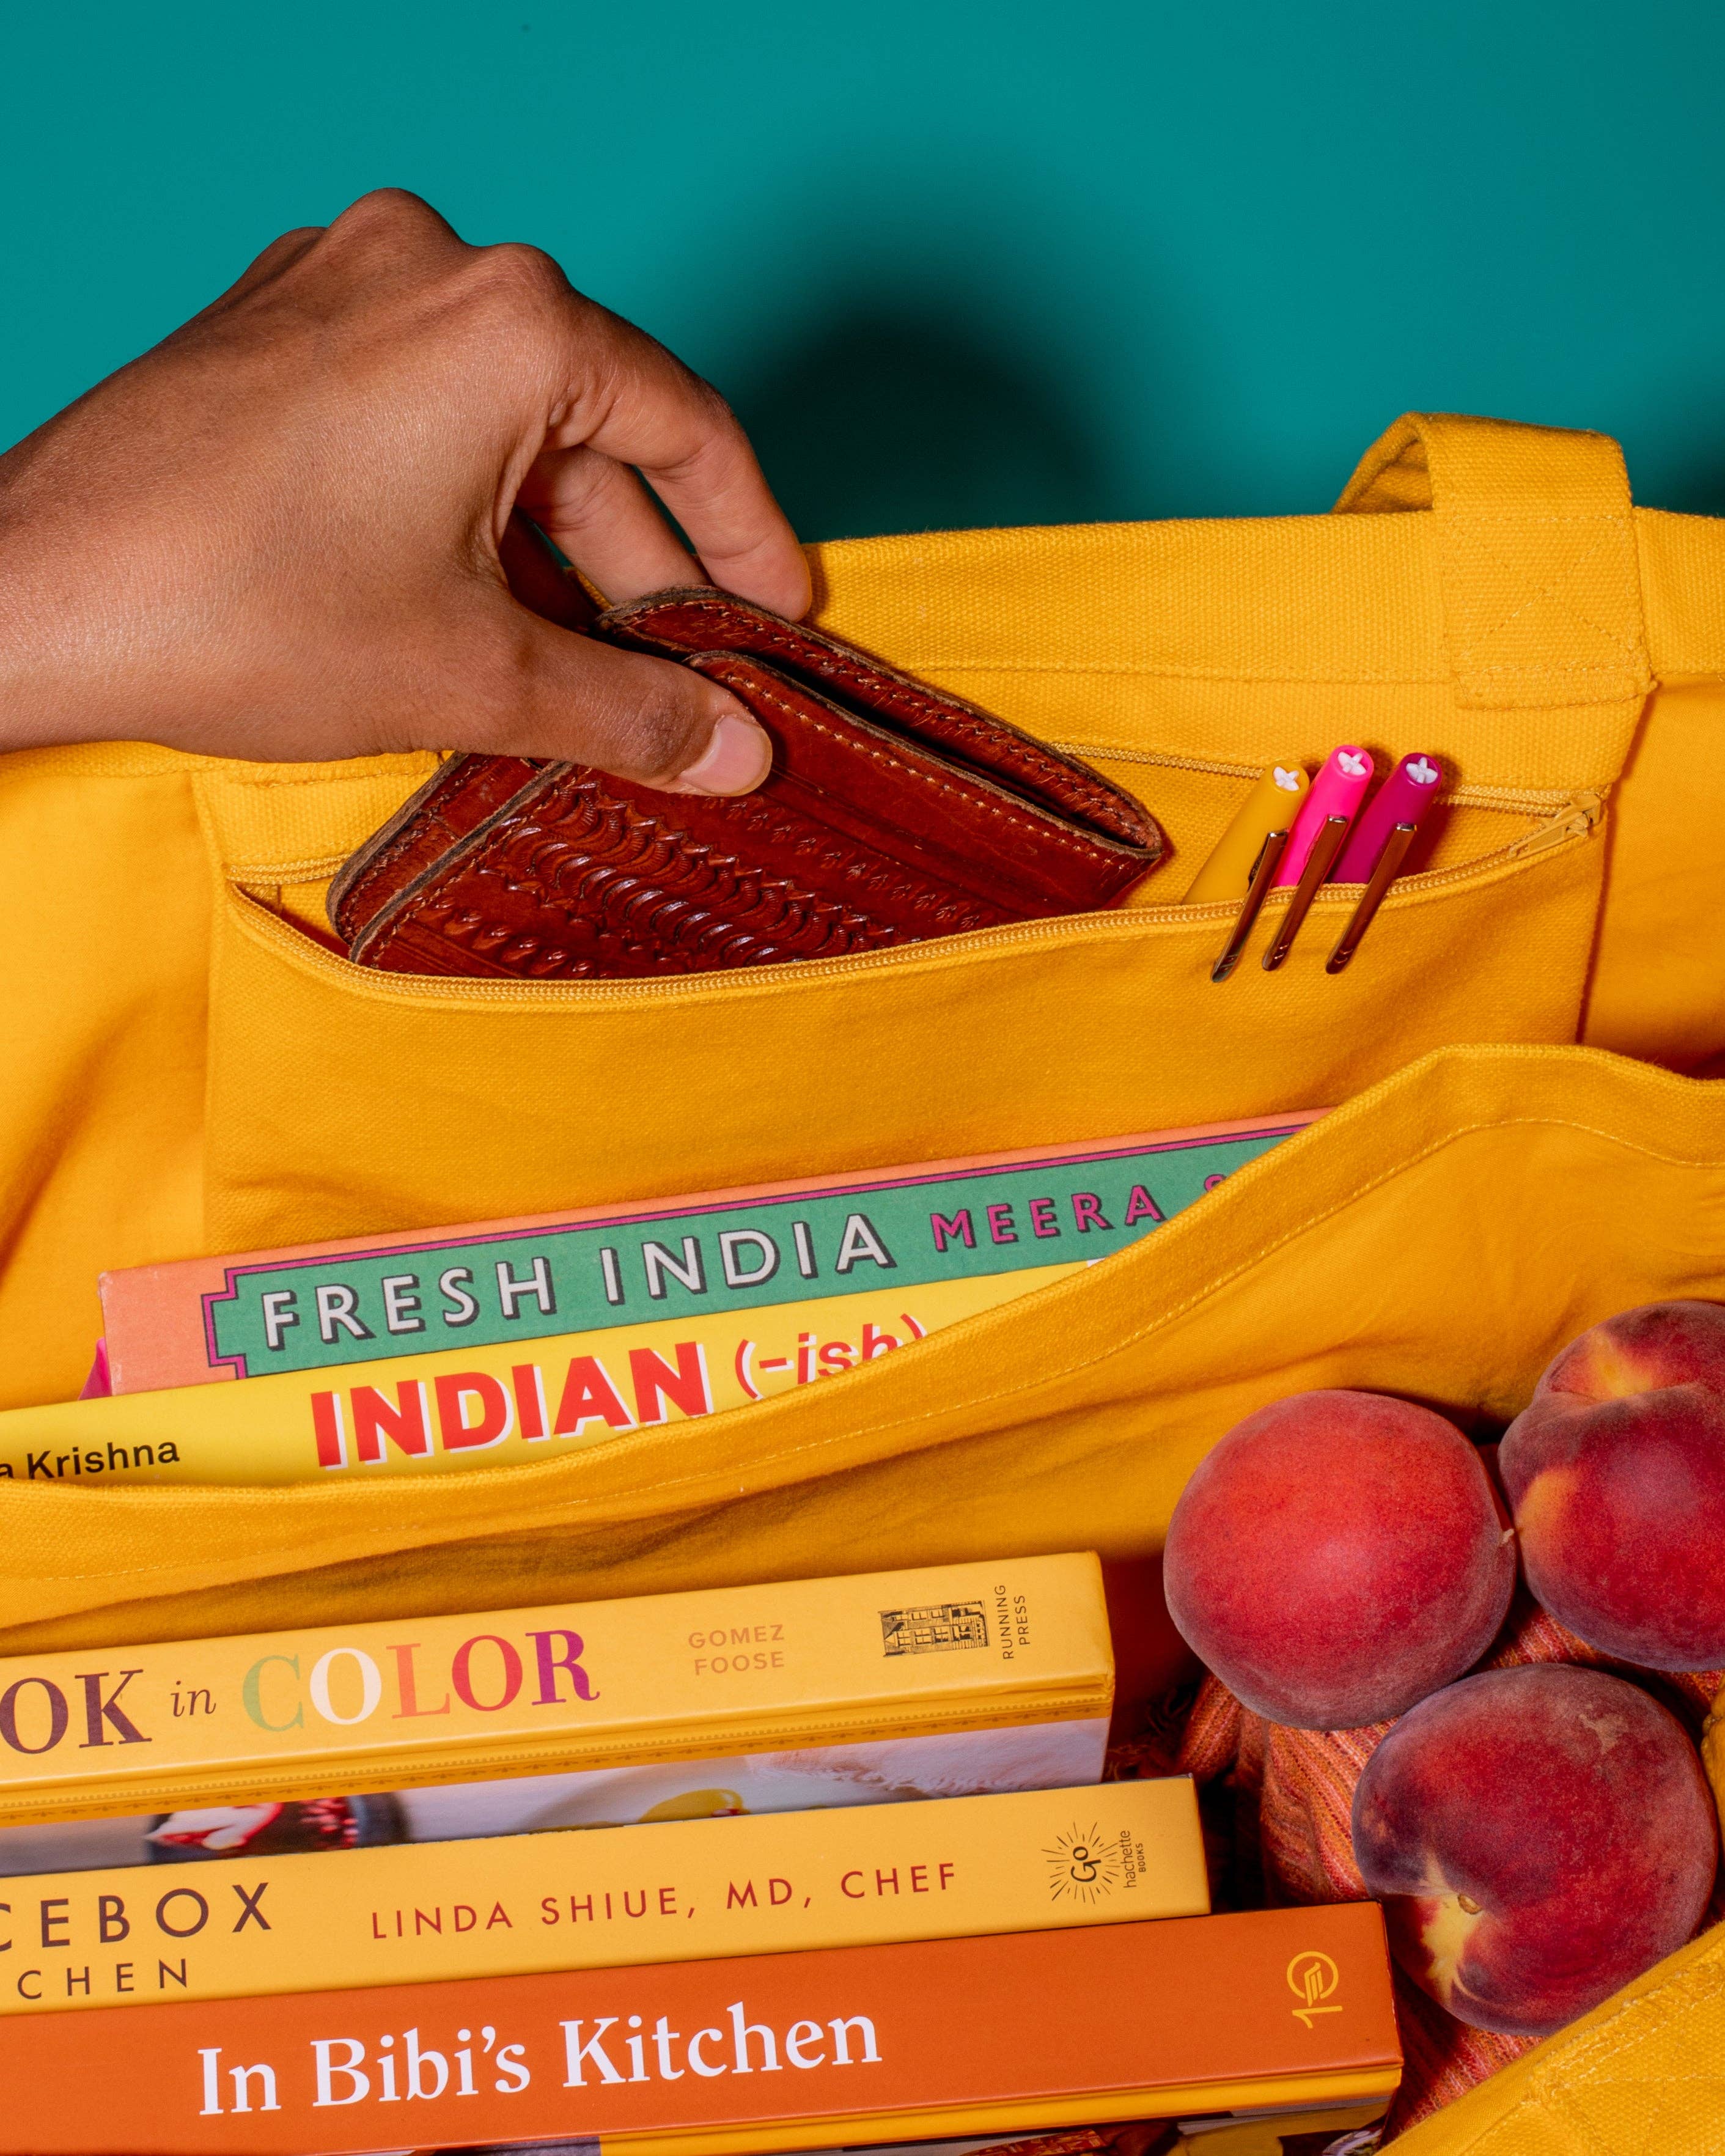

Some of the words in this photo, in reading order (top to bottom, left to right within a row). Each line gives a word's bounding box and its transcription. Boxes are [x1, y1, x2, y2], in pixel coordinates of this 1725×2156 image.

[261, 1257, 557, 1352] FRESH
[600, 1213, 897, 1305] INDIA
[930, 1185, 1167, 1253] MEERA
[311, 1341, 714, 1471] INDIAN
[27, 1441, 180, 1480] Krishna
[688, 1624, 785, 1649] GOMEZ
[995, 1585, 1014, 1659] RUNNING
[1013, 1595, 1031, 1645] PRESS
[694, 1650, 785, 1676] FOOSE
[0, 1669, 152, 1754] OK
[170, 1680, 216, 1718] in
[242, 1630, 600, 1732] COLOR
[1070, 1846, 1102, 1882] Go
[1119, 1830, 1137, 1888] hachette
[1135, 1843, 1146, 1872] BOOKS
[372, 1901, 513, 1940] LINDA
[541, 1887, 696, 1926] SHIUE,
[727, 1877, 812, 1910] MD,
[840, 1863, 957, 1900] CHEF
[17, 1959, 188, 2000] CHEN
[197, 2047, 282, 2116] In
[311, 2025, 531, 2108] Bibi’s
[559, 2001, 883, 2088] Kitchen
